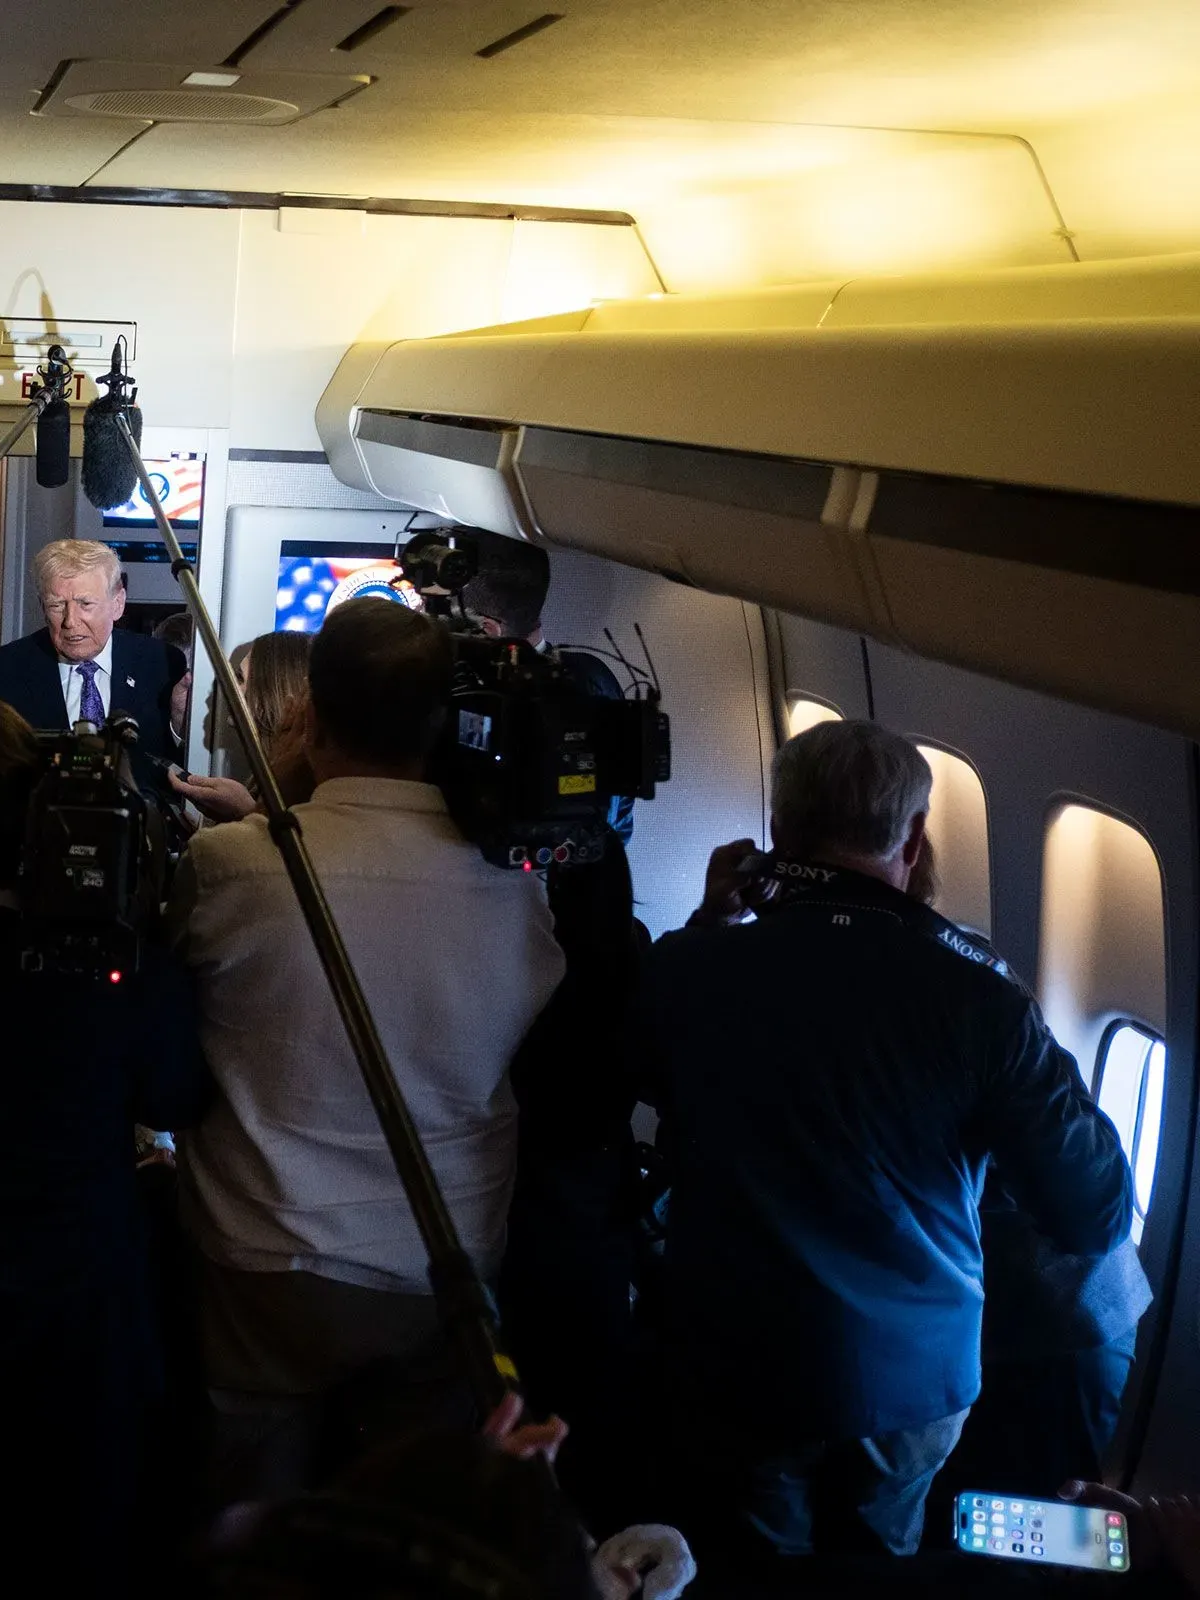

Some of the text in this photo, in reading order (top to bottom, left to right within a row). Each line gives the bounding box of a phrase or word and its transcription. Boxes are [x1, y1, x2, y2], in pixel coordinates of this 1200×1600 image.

[22, 373, 85, 400] ET
[774, 861, 838, 883] SONY
[938, 928, 984, 963] SONY
